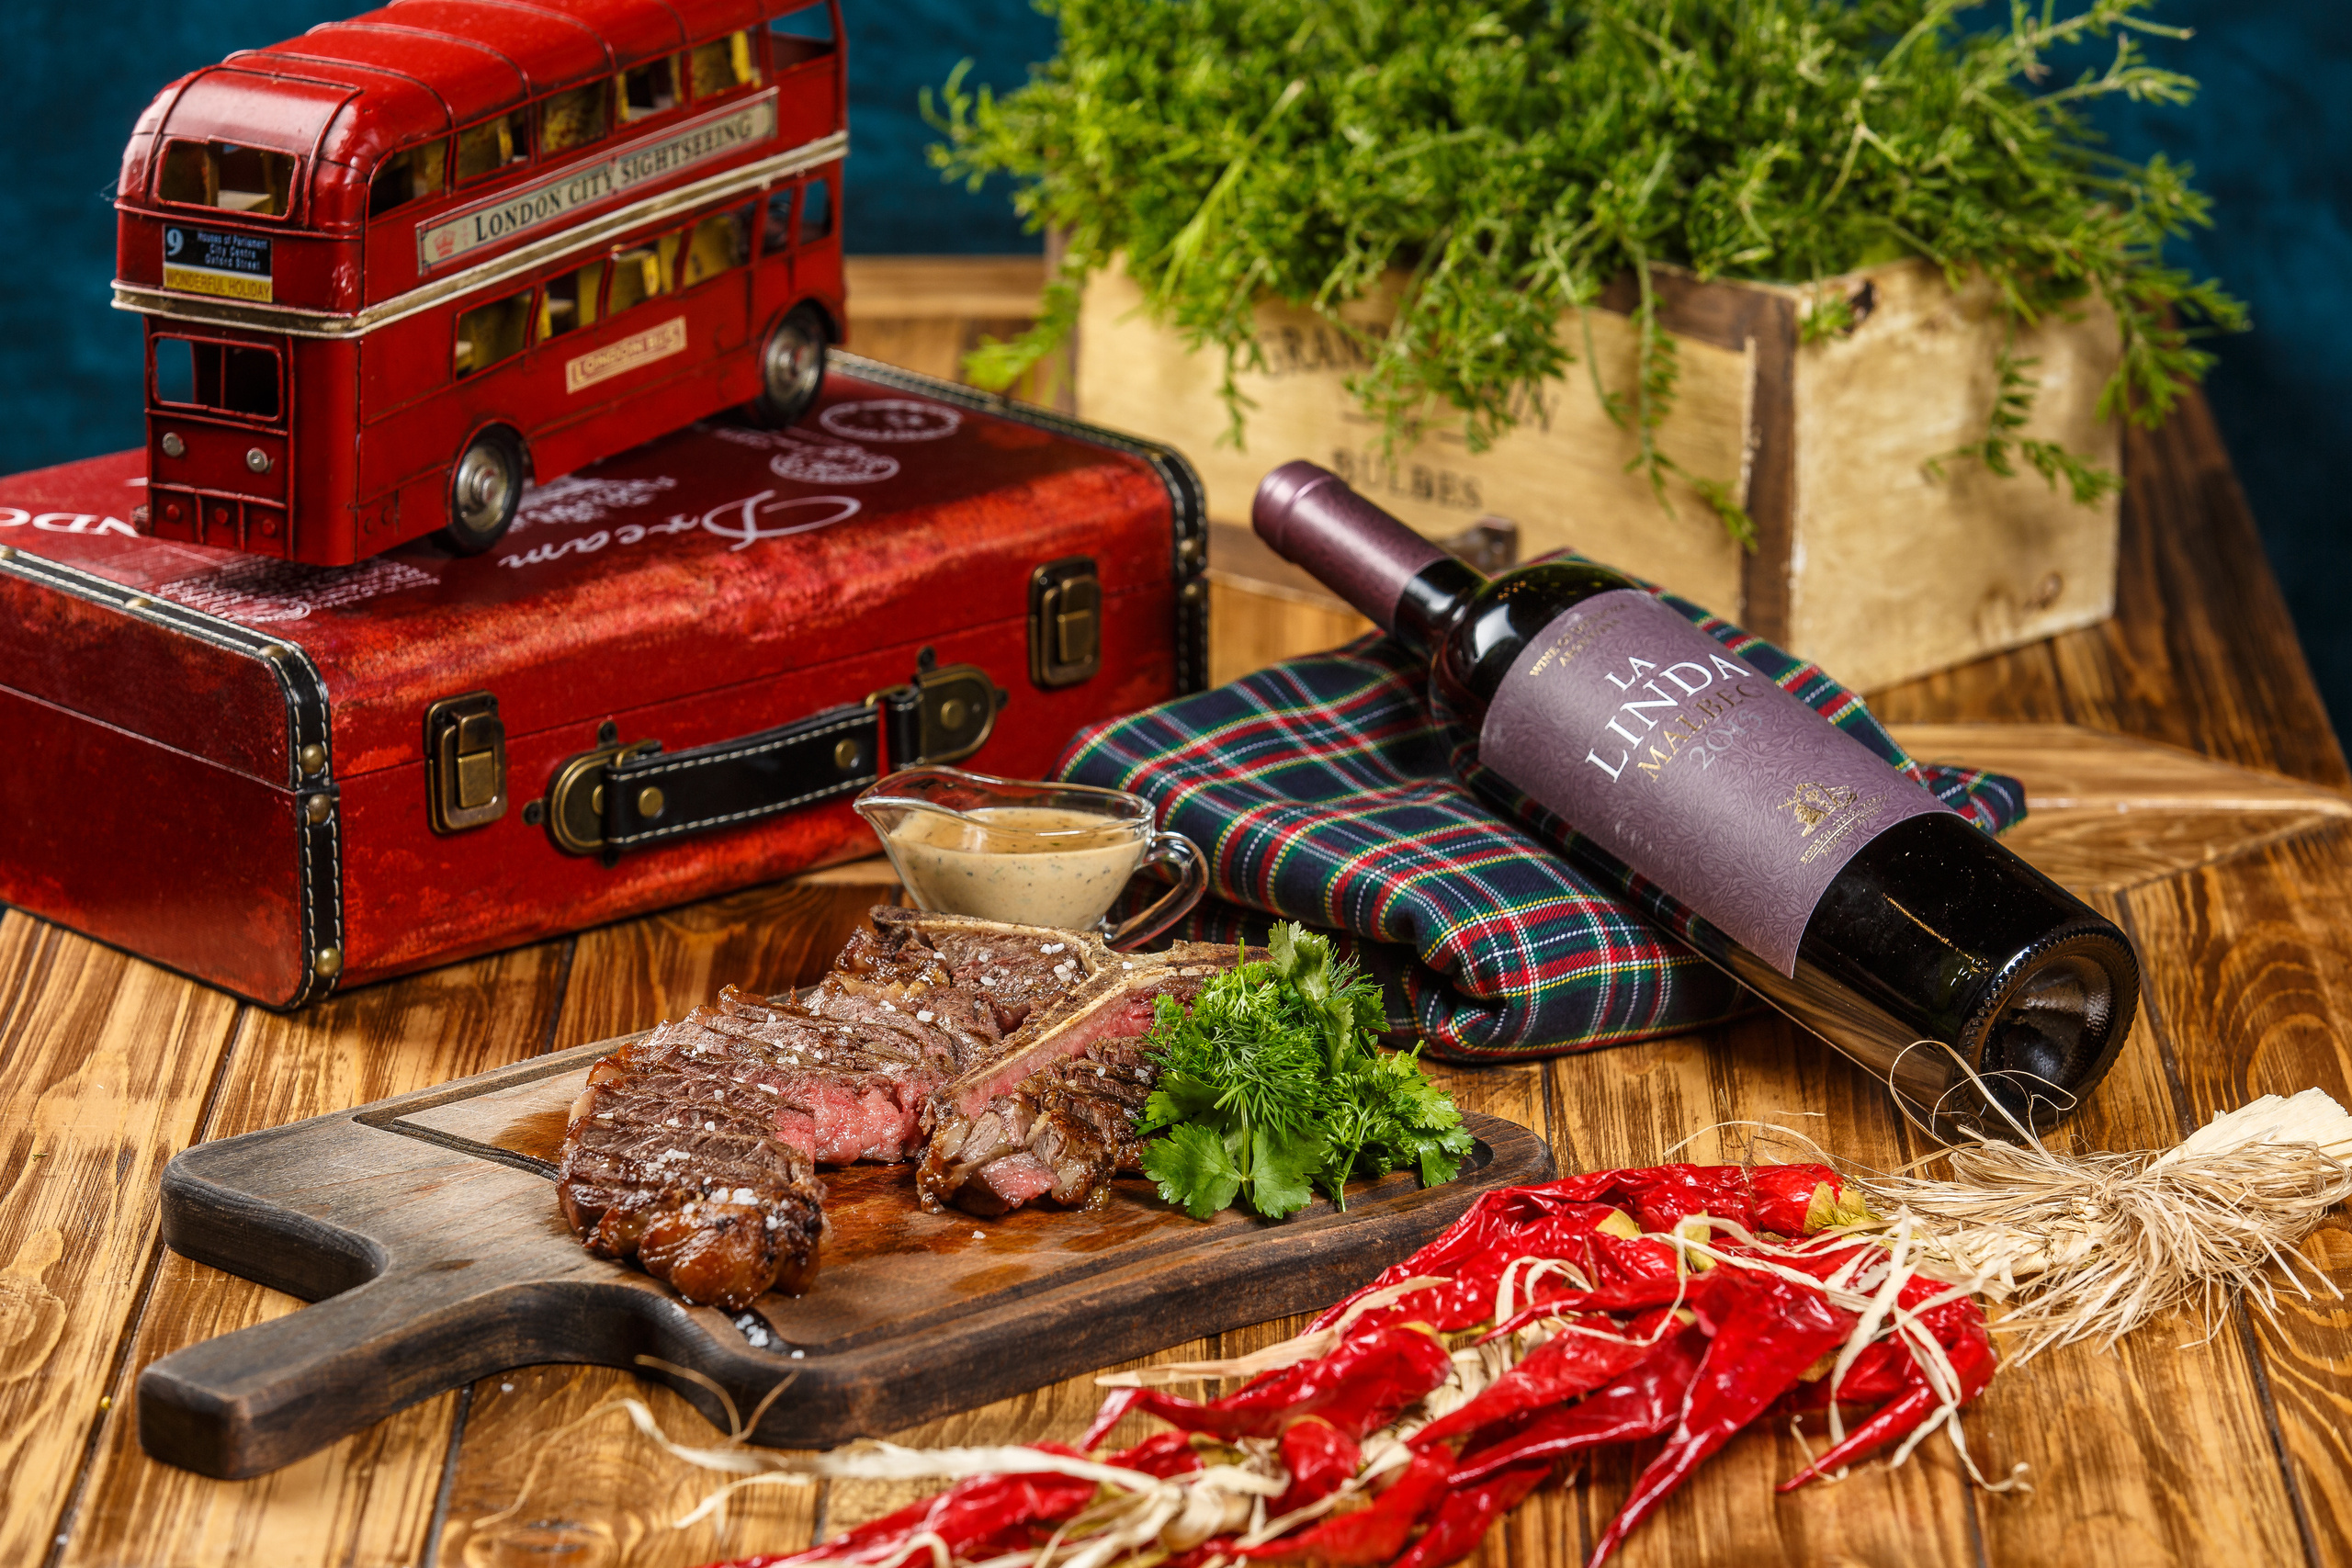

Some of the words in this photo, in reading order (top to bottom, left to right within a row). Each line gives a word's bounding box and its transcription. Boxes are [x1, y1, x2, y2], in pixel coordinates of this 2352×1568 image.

[475, 189, 562, 243] LONDON
[569, 167, 616, 204] CITY
[621, 113, 752, 184] SIGHTSEEING
[167, 228, 184, 256] 9
[198, 231, 222, 243] Houses
[223, 234, 232, 245] of
[232, 234, 268, 250] Parliament
[209, 243, 227, 257] City
[229, 244, 256, 260] Centre
[205, 253, 233, 267] Oxford
[235, 259, 260, 271] Street
[228, 278, 270, 299] HOLIDAY
[1529, 646, 1560, 676] WINE
[1604, 656, 1657, 692] LA
[1585, 653, 1752, 784] LINDA
[1637, 682, 1764, 783] MALBEC
[1689, 709, 1762, 770] 2015
[1800, 829, 1832, 864] BODEGA
